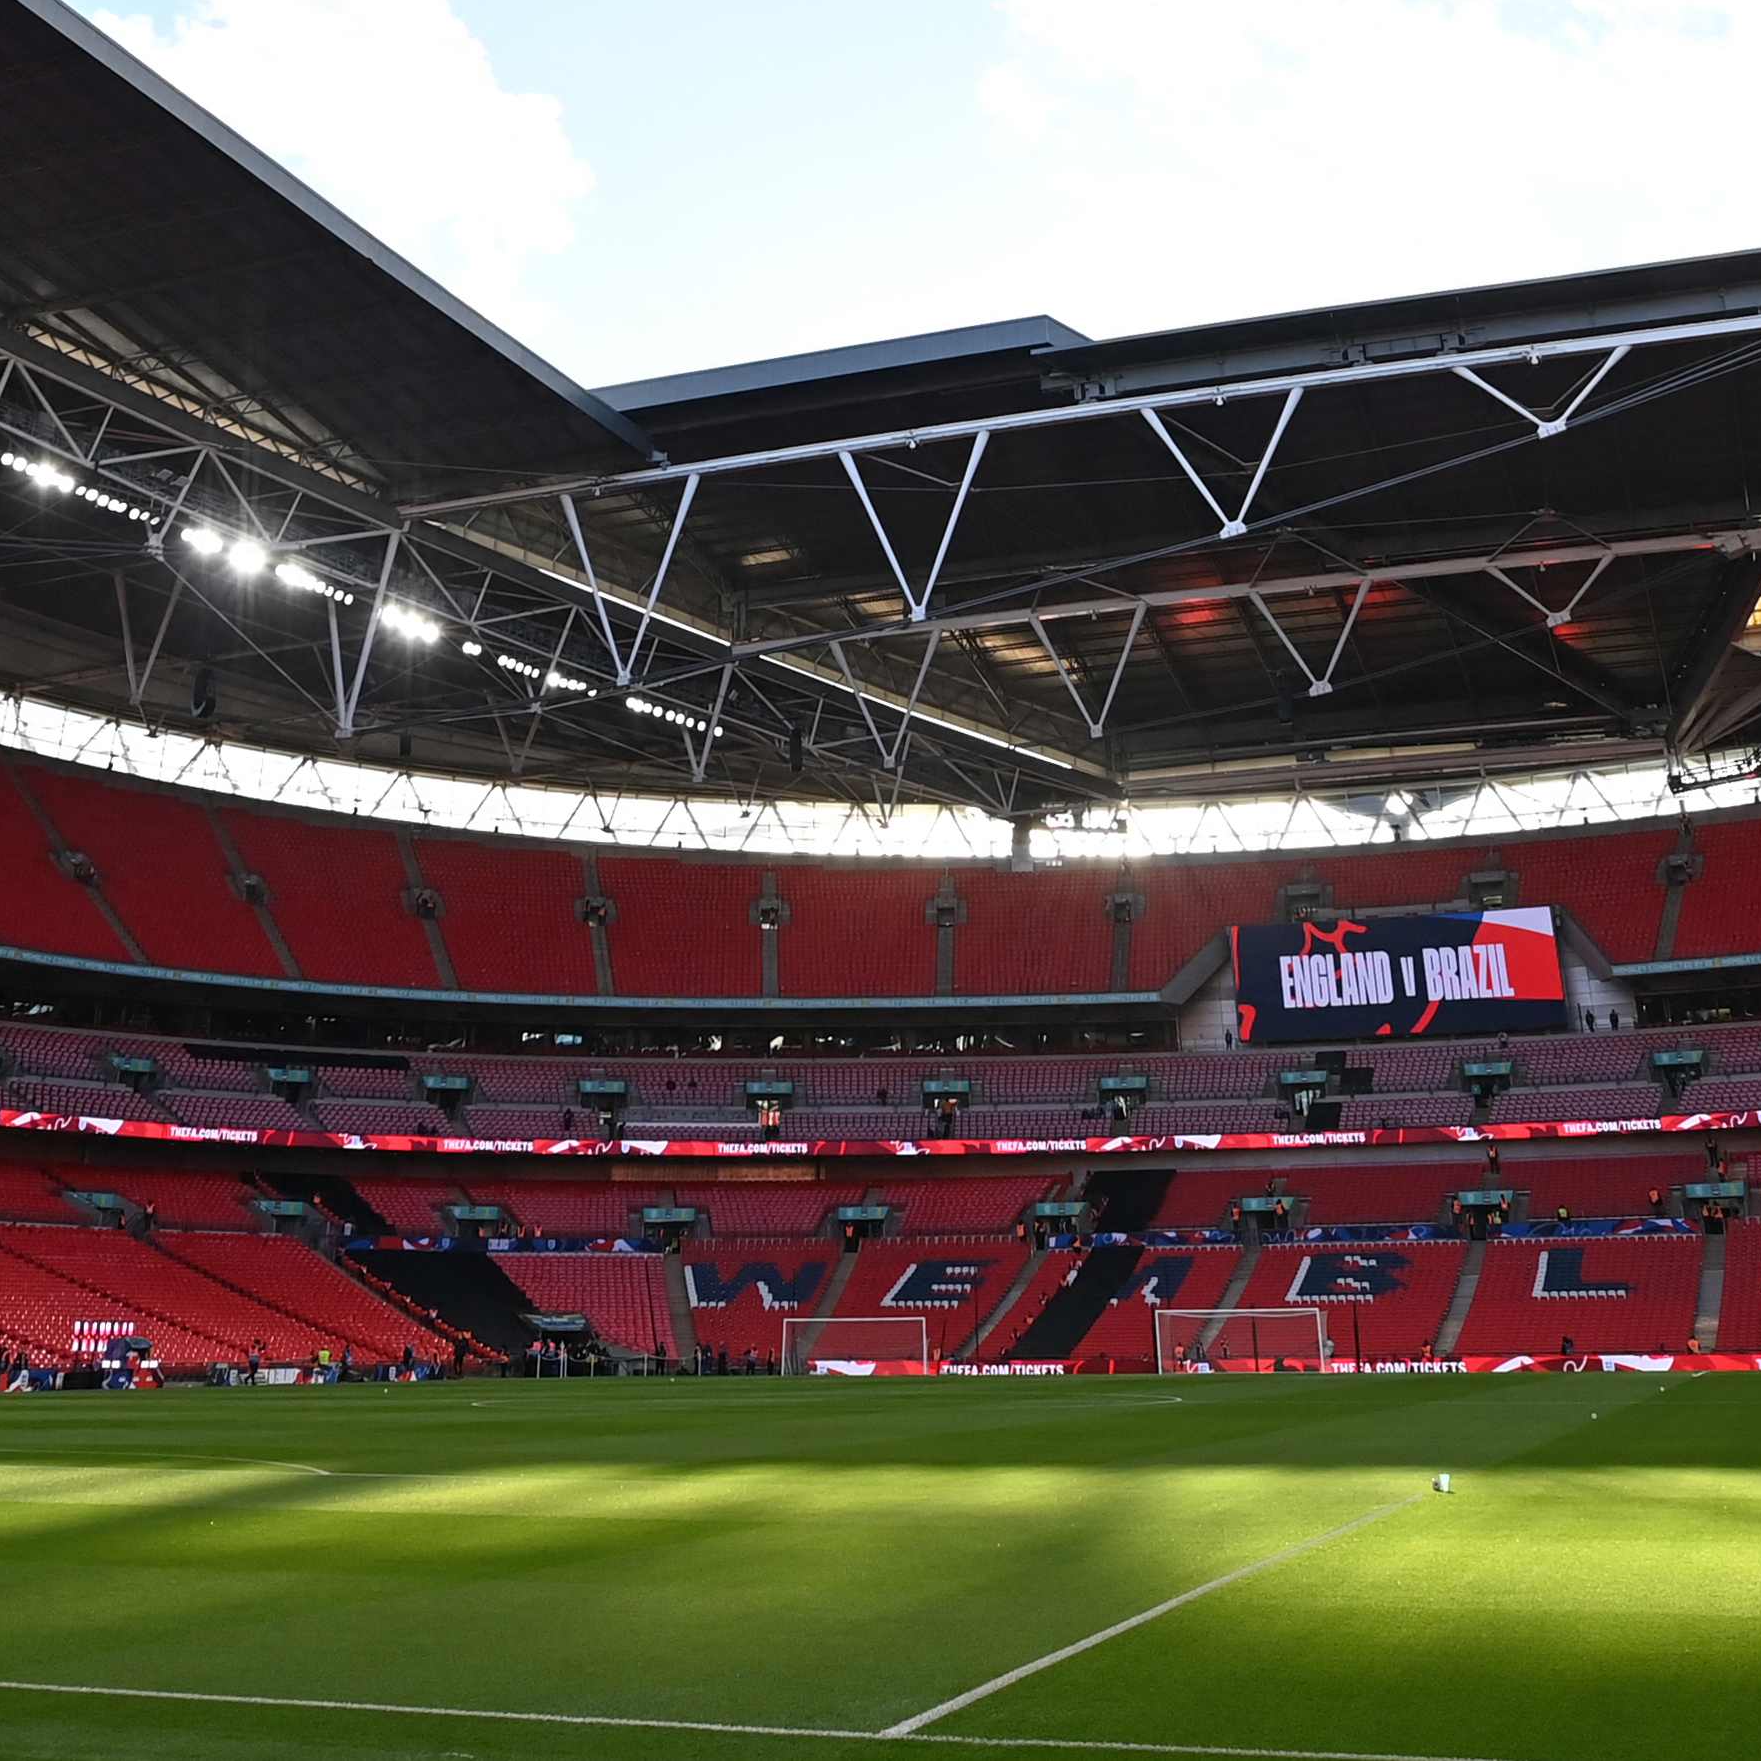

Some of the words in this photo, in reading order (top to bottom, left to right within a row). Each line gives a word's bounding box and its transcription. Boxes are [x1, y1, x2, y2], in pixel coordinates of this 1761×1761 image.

[1279, 951, 1394, 1009] ENGLAND
[1422, 943, 1515, 1002] BRAZIL
[1563, 1118, 1662, 1134] THEFA.COM/TICKETS
[169, 1126, 258, 1143] THEFA.COM/TICKETS
[1272, 1131, 1366, 1146] THEFA.COM/TICKETS
[443, 1139, 534, 1153] THEFA.COM/TICKETS
[717, 1141, 808, 1155] THEFA.COM/TICKETS
[995, 1140, 1086, 1152] THEFA.COM/TICKETS
[942, 1363, 1064, 1376] THEFA.COM/TICKETS
[1330, 1361, 1467, 1374] THEFA.COM/TICKETS
